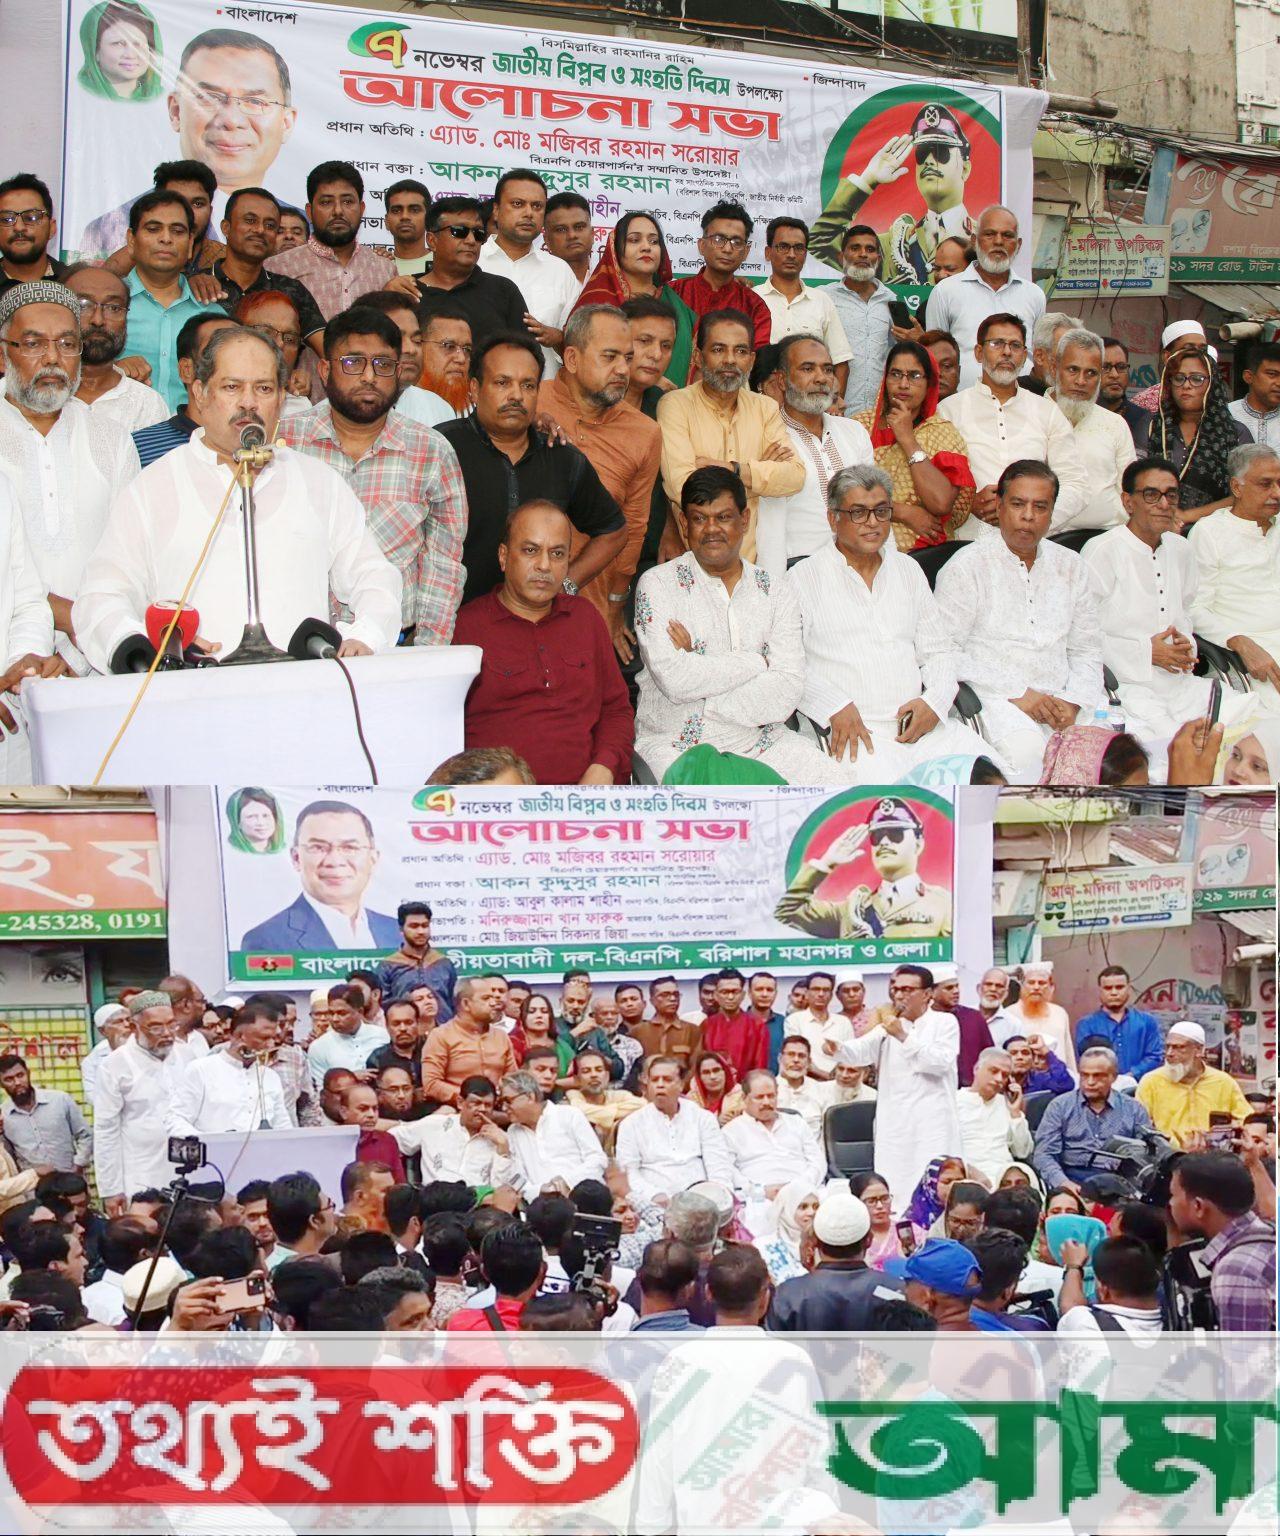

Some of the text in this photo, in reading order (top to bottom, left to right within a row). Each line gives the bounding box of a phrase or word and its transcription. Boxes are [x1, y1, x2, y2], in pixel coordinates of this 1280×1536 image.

[226, 5, 297, 25] বাংলাদেশ
[541, 36, 694, 65] বিসমিল্লাহির রাহমানির রাহিম
[412, 50, 486, 73] নভেম্বর
[492, 46, 552, 77] জাতীয়
[557, 51, 607, 87] বিপ্লব
[610, 66, 626, 85] ও
[630, 64, 683, 92] সংহতি
[687, 67, 730, 97] দিবস
[812, 72, 868, 91] জিন্দাবাদ
[339, 69, 783, 142] আলোচনা সভা
[326, 120, 364, 134] প্রধান
[369, 121, 414, 137] অতিথি
[537, 127, 602, 157] মজিবর
[608, 138, 666, 162] রহমান
[672, 144, 740, 168] সরোয়ার
[529, 153, 571, 167] বিএনপি
[648, 163, 688, 177] সম্মানিত
[386, 161, 672, 196] বক্তা আকন রহমান
[1190, 260, 1214, 272] সদর
[1218, 260, 1244, 274] রোড,
[1249, 259, 1274, 272] টাউন
[461, 800, 512, 814] নভেম্বর
[519, 792, 564, 813] জাতীয়
[568, 793, 606, 815] বিপ্লব
[610, 799, 621, 812] ও
[626, 793, 668, 812] সংহতি
[671, 792, 707, 812] দিবস
[408, 819, 751, 848] আলোচনা সভা
[556, 847, 604, 864] মজিবর
[610, 850, 655, 864] রহমান
[475, 877, 530, 889] আকন
[605, 874, 660, 889] রহমান
[514, 896, 545, 910] আবুল
[551, 895, 585, 907] কালাম
[589, 891, 622, 907] শাহীন
[561, 928, 600, 941] সিকদার
[604, 927, 629, 941] জিয়া
[299, 955, 385, 975] বাংলাদে
[697, 943, 770, 965] বরিশাল
[778, 943, 855, 962] মহানগর
[861, 943, 877, 959] ও
[883, 941, 933, 959] জেলা
